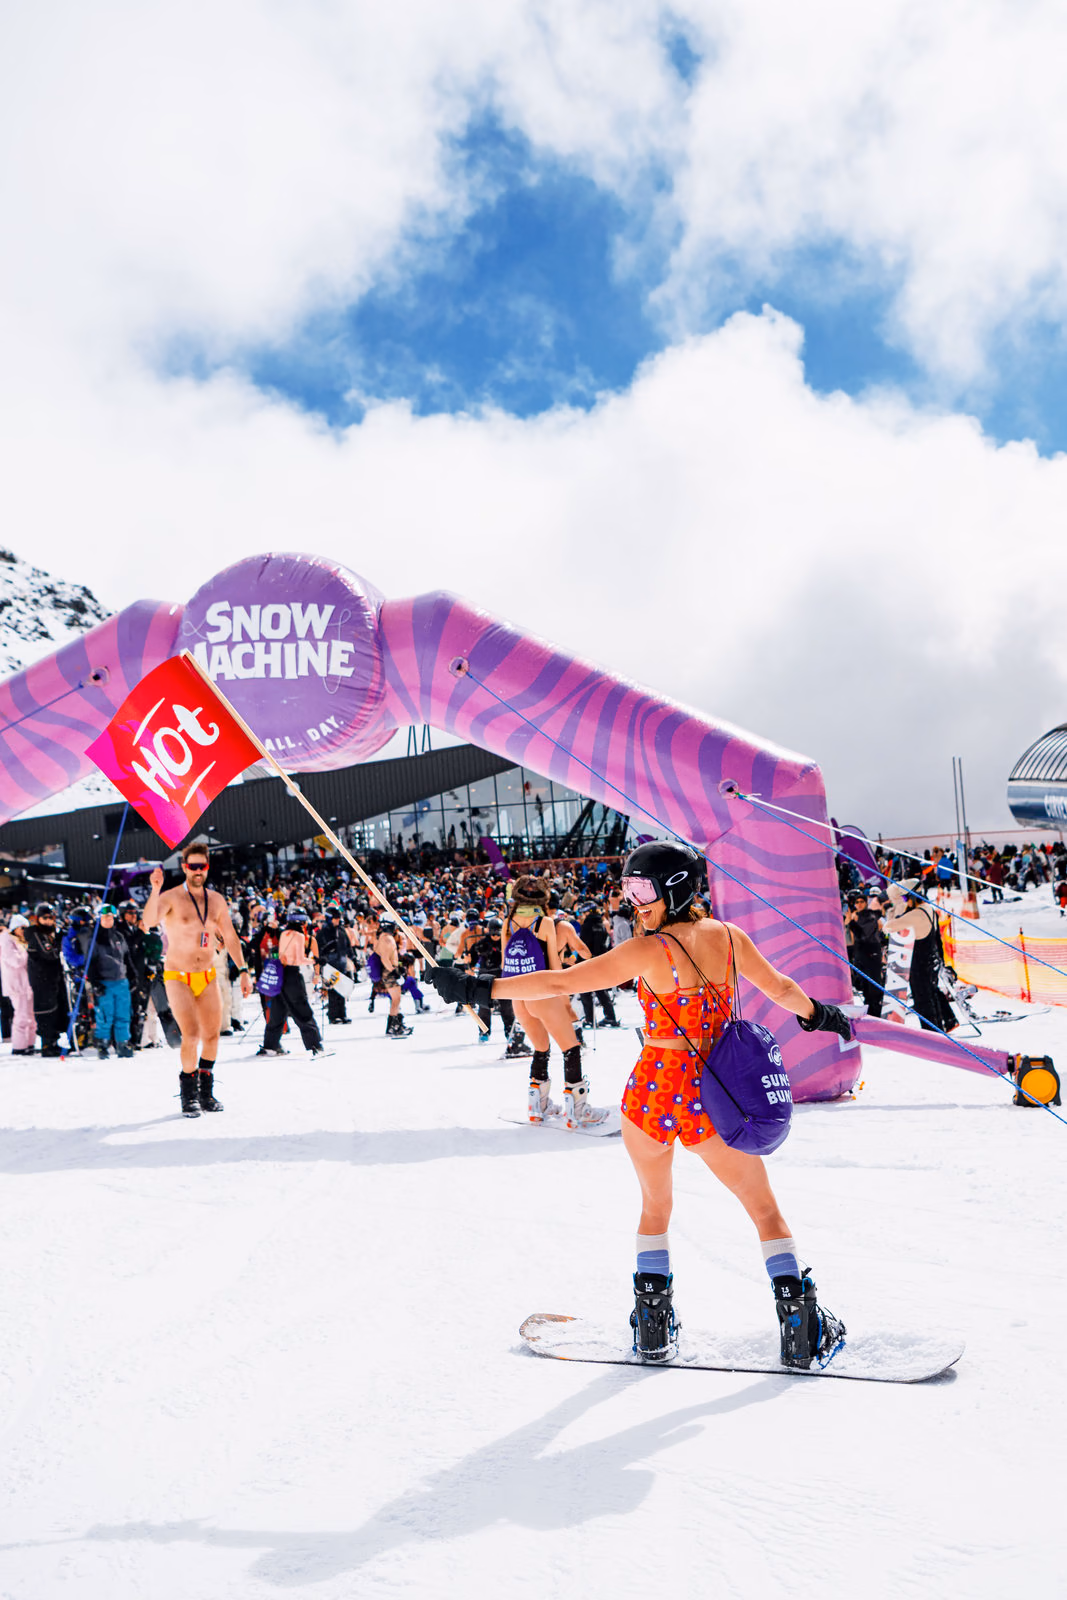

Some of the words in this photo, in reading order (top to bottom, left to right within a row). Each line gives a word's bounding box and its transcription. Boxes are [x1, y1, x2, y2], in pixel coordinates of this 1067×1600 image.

[206, 601, 336, 644] SNOW
[265, 736, 302, 751] ALL.
[306, 715, 344, 742] DAY.
[520, 956, 534, 965] OUT
[521, 964, 536, 973] OUT
[766, 1090, 792, 1105] BUN
